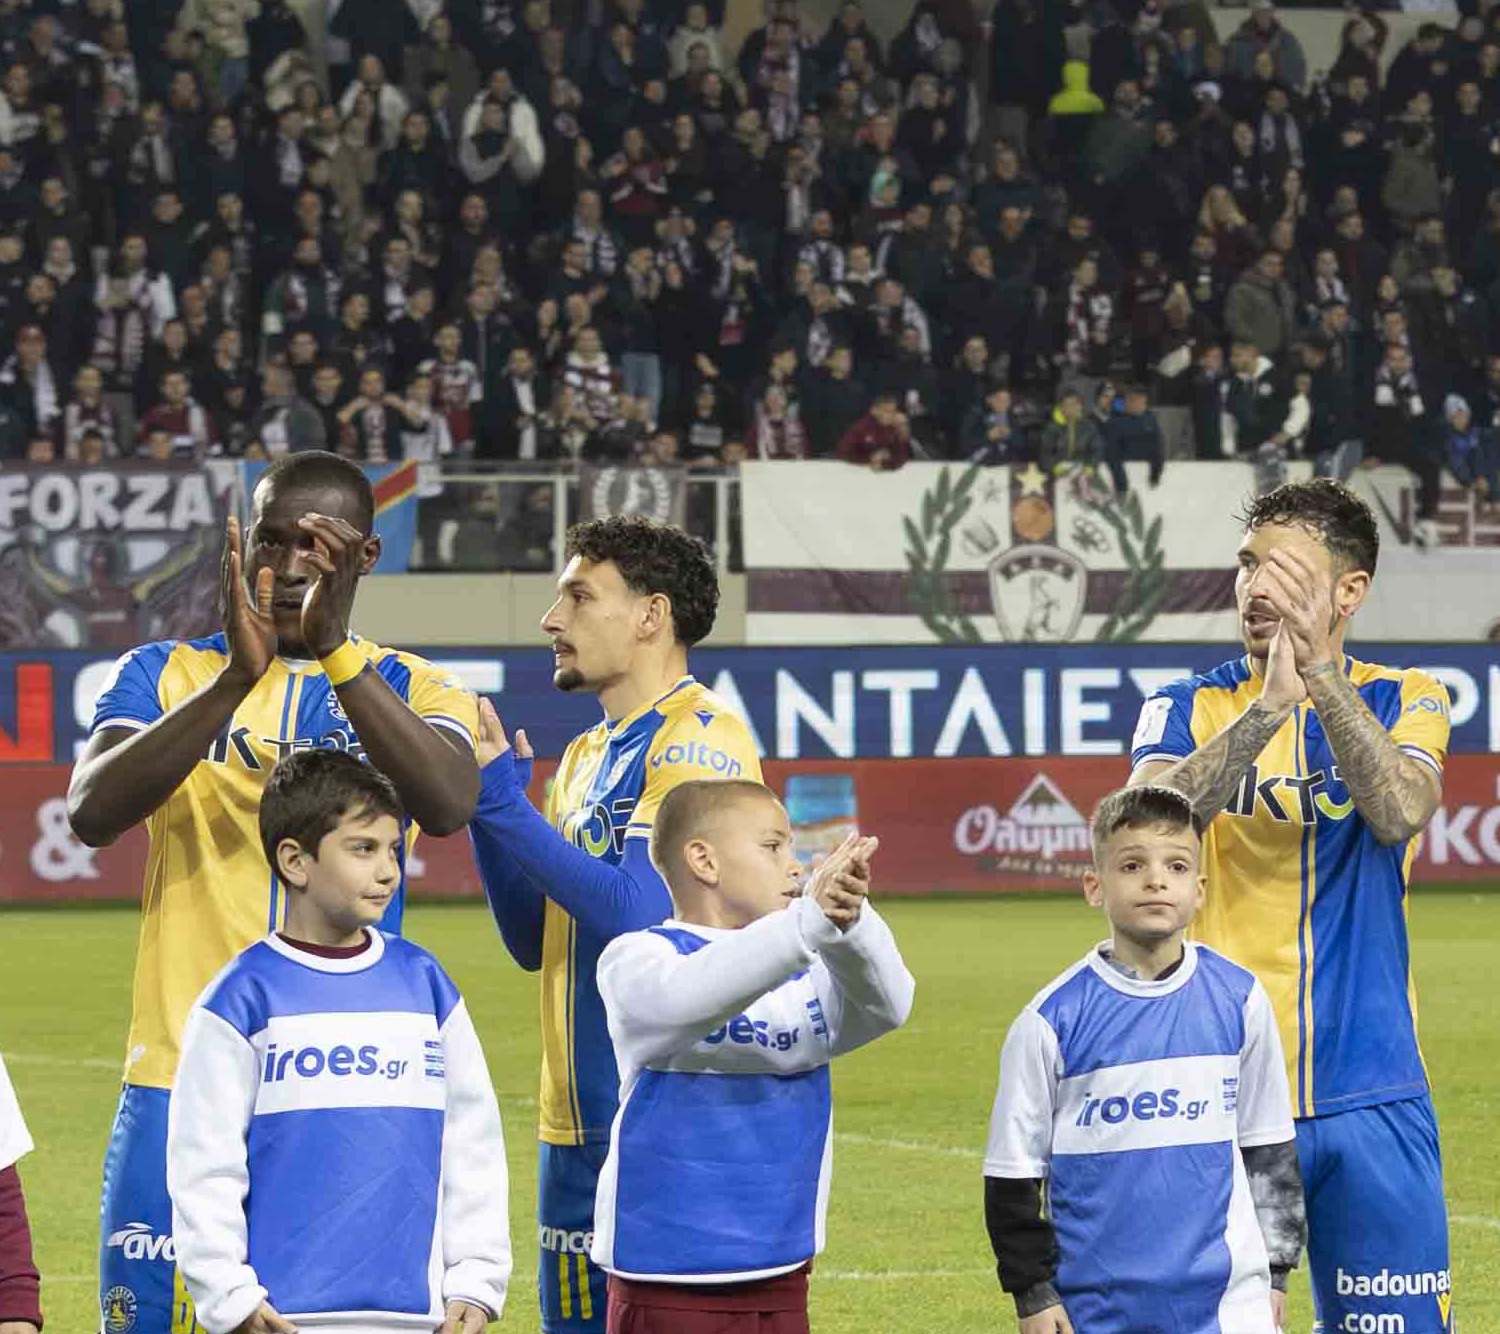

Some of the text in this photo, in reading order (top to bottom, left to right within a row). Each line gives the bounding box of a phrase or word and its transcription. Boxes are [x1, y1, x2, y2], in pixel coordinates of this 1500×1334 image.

[263, 1042, 409, 1084] iroes.gr
[1075, 1087, 1210, 1128] iroes.gr
[558, 1252, 595, 1321] 11
